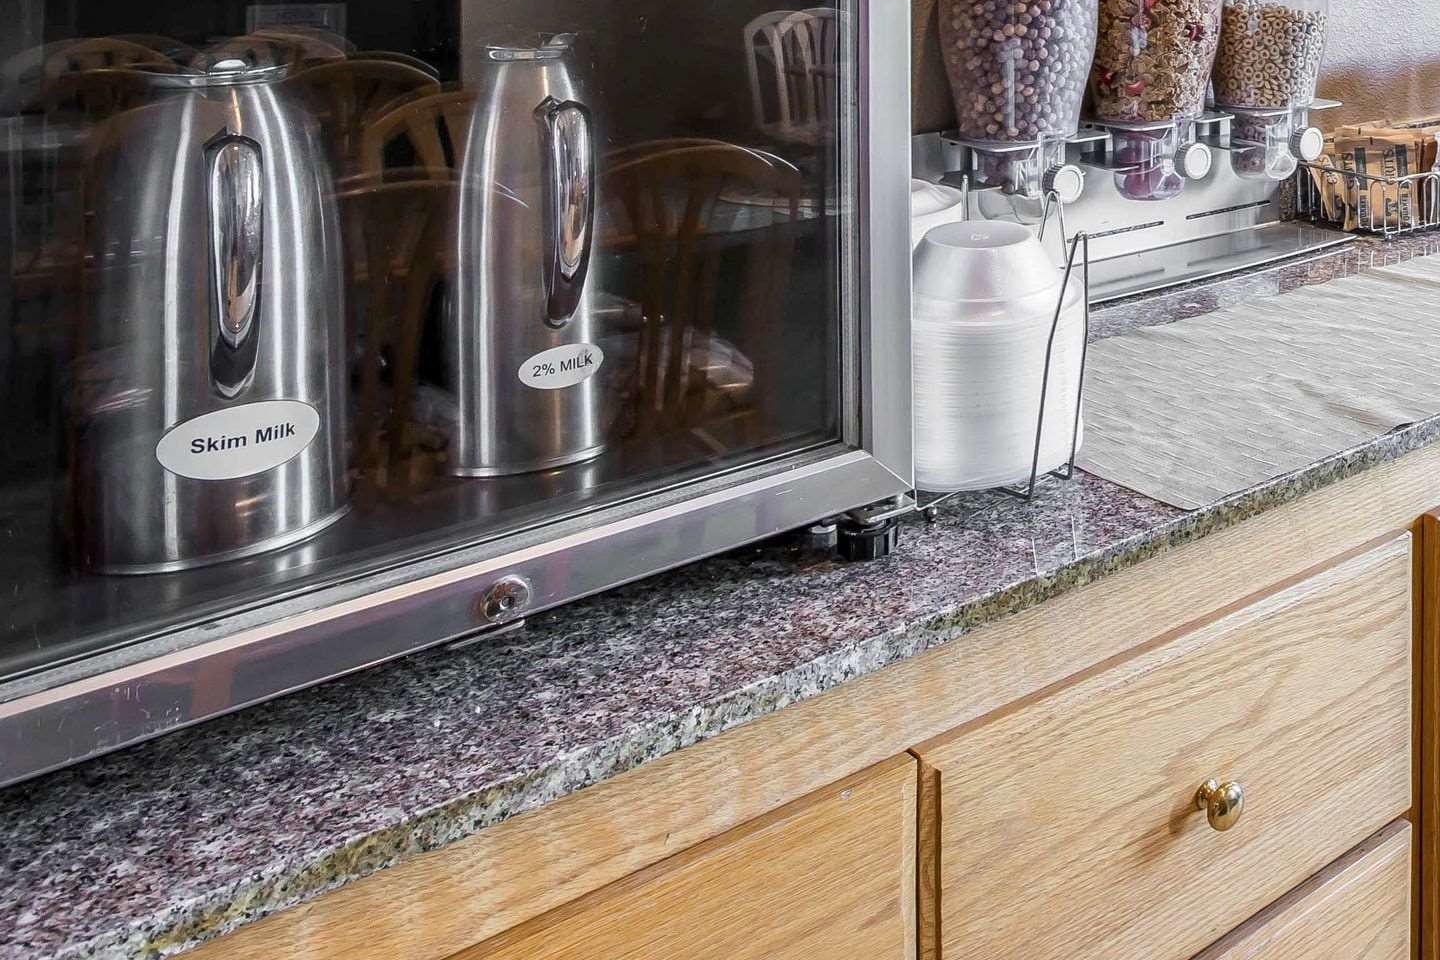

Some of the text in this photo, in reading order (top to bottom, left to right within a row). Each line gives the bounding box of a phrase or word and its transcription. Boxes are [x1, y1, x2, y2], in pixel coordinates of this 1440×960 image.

[532, 352, 594, 378] 2% MILK
[190, 422, 296, 454] Skim Milk
